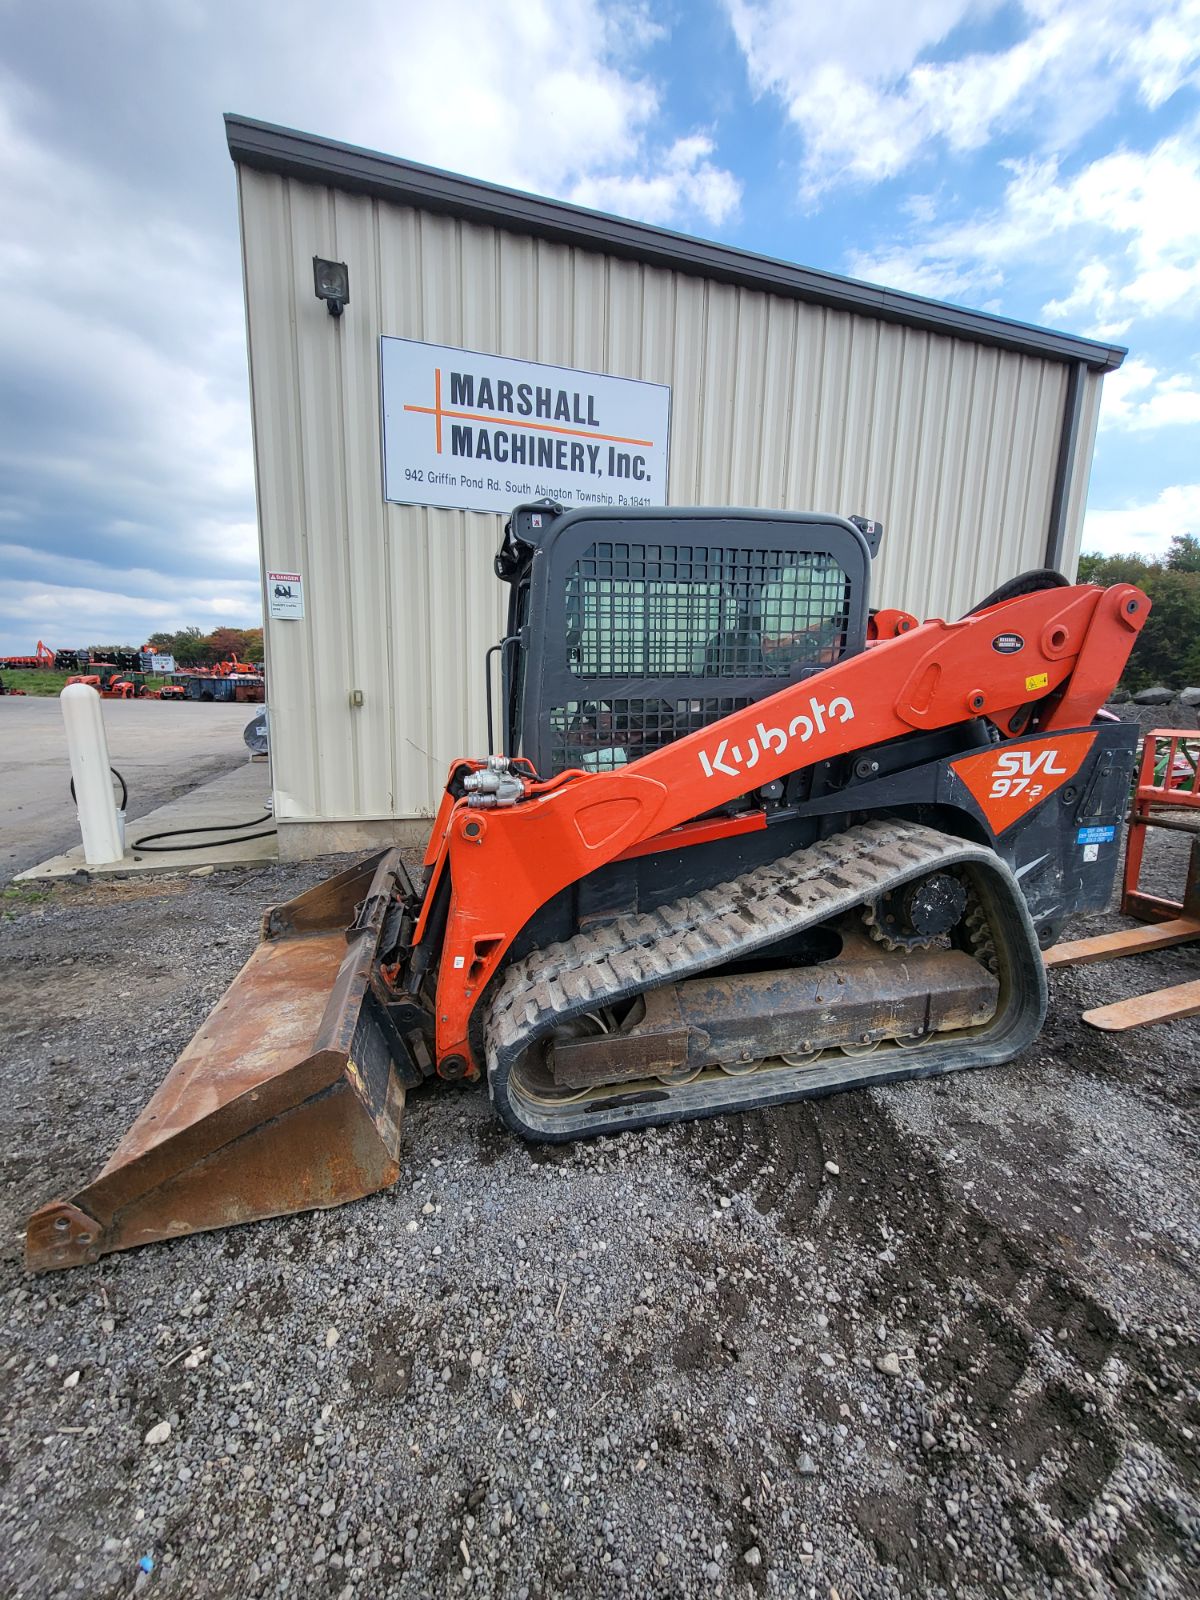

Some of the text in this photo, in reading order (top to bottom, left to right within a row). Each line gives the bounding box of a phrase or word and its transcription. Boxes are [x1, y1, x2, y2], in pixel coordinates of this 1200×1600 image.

[450, 371, 600, 427] MARSHALL
[451, 424, 651, 482] MACHINERY, Inc.
[404, 468, 424, 482] 942
[427, 471, 457, 486] Griffin
[460, 475, 484, 489] Pond
[487, 478, 502, 491] Rd.
[505, 481, 531, 495] South
[535, 484, 573, 500] Abington
[698, 696, 855, 778] Kubota
[991, 750, 1067, 777] SVL
[988, 778, 1044, 799] 97-2
